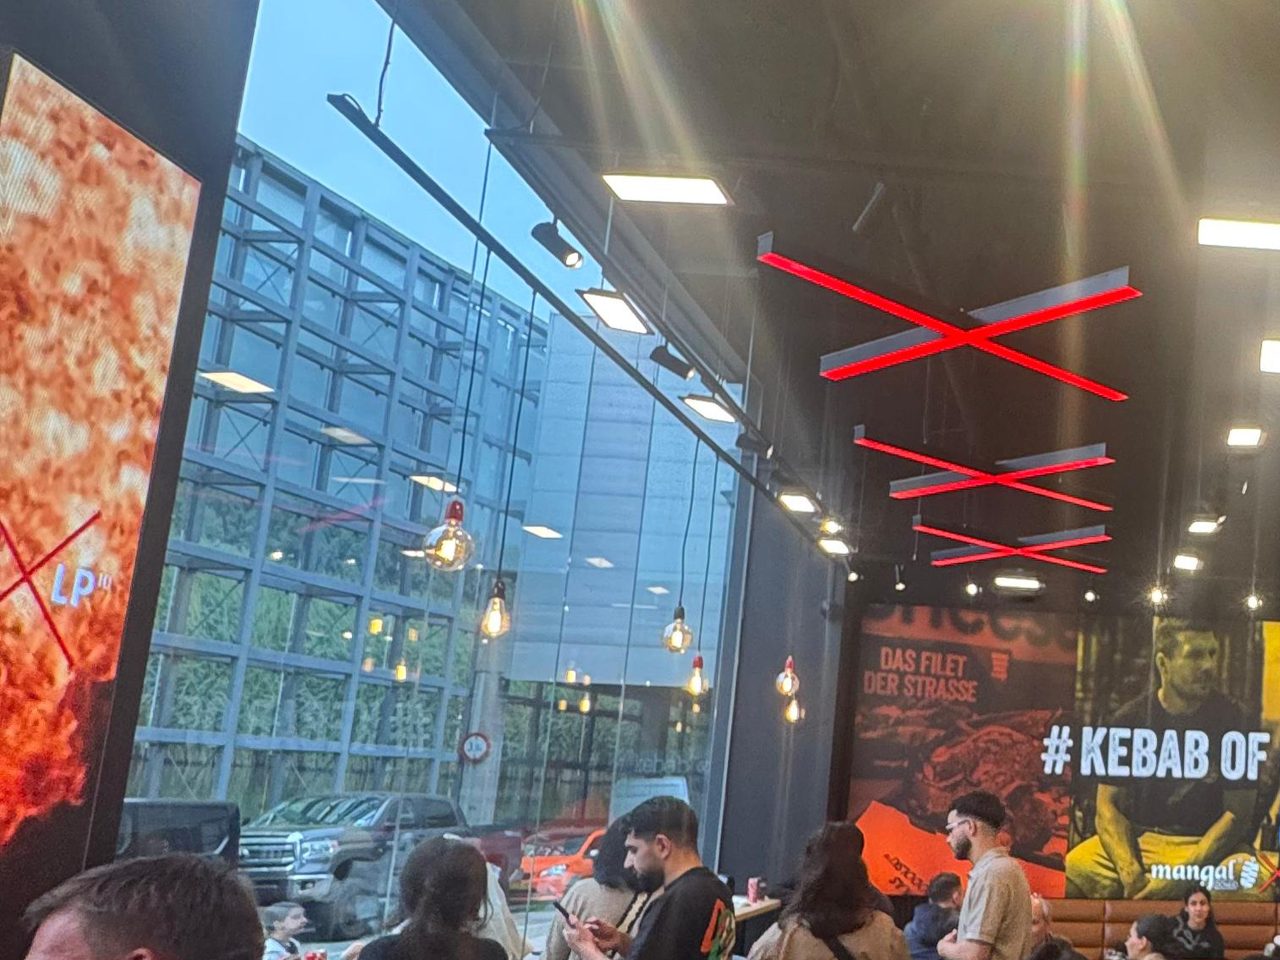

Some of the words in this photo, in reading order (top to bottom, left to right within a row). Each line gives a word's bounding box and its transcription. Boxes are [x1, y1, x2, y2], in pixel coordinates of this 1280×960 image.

[880, 647, 917, 671] DAS
[920, 652, 968, 677] FILET
[863, 671, 899, 695] DER
[903, 675, 978, 703] STRASSE
[1080, 726, 1209, 779] KEBAB
[1220, 730, 1270, 781] OF
[1151, 859, 1235, 891] mangal
